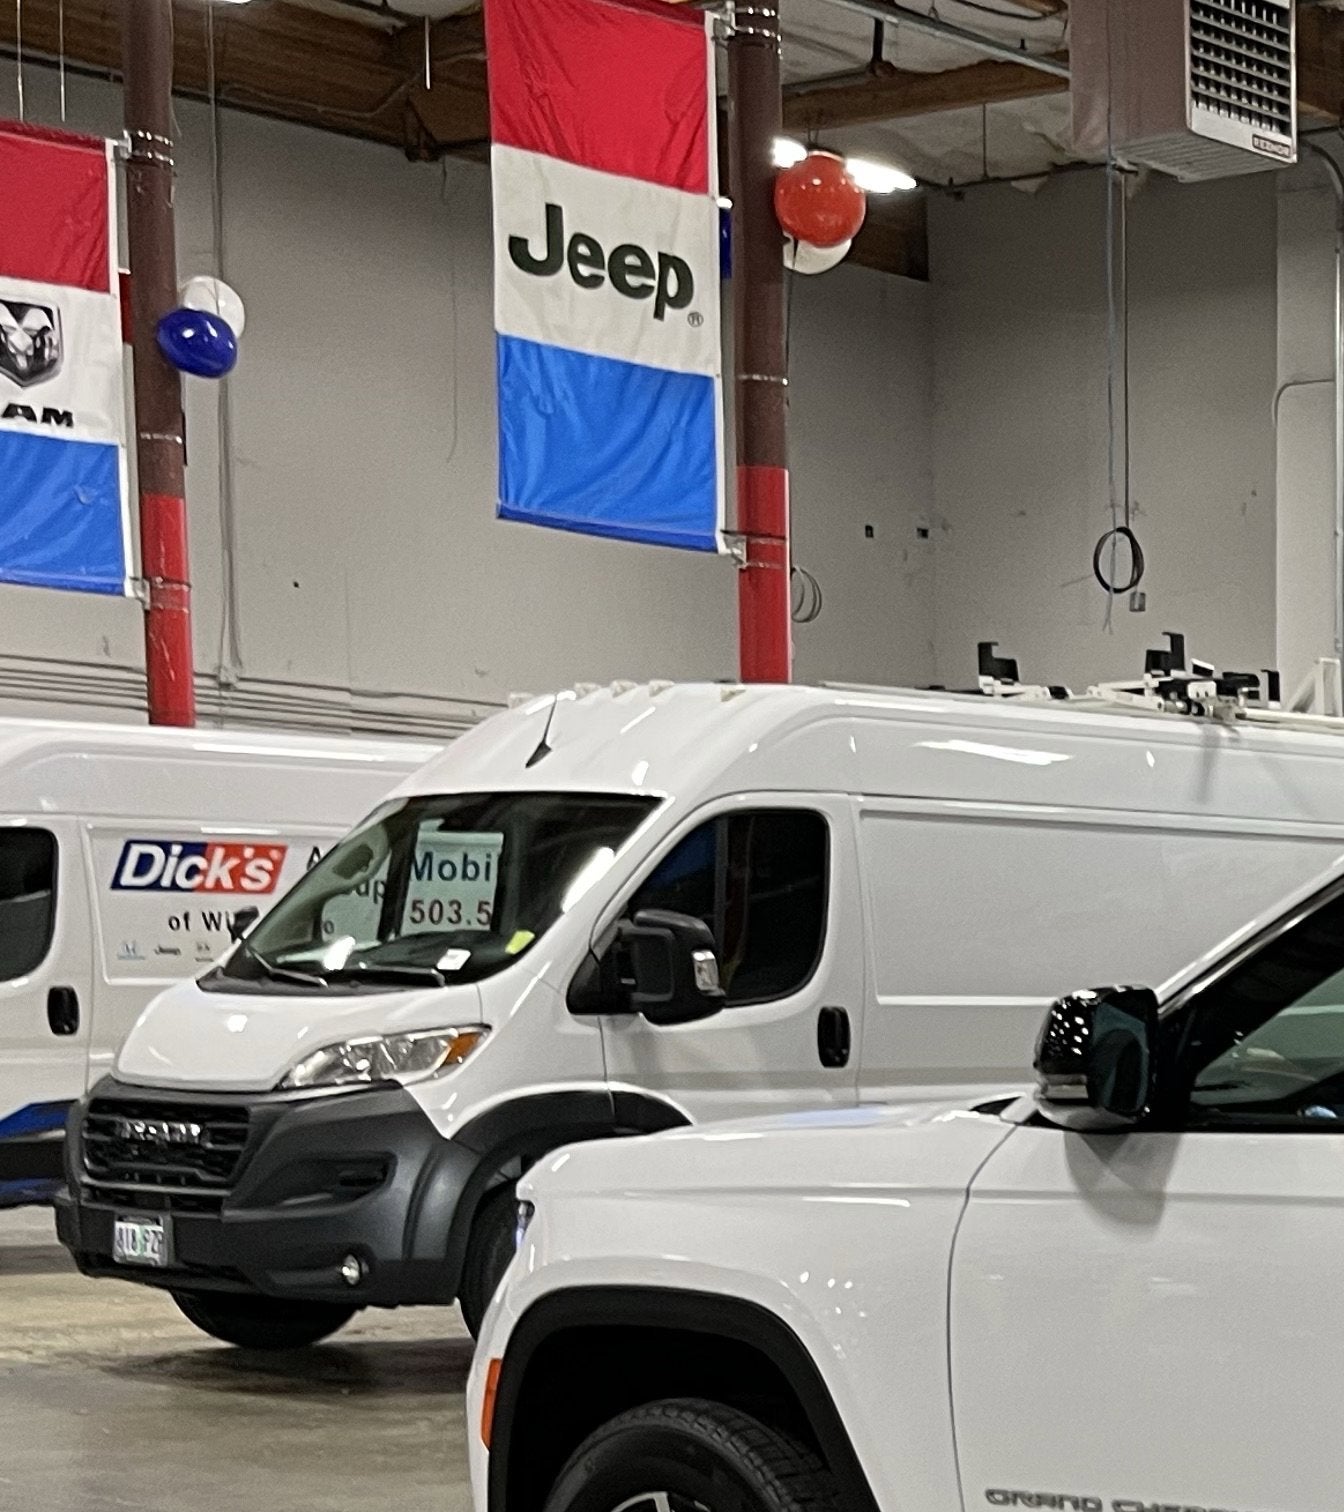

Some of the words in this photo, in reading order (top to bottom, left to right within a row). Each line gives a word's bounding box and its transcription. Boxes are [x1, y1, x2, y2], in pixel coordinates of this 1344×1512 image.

[508, 203, 694, 322] Jeep
[0, 402, 75, 428] AM
[168, 911, 190, 931] of
